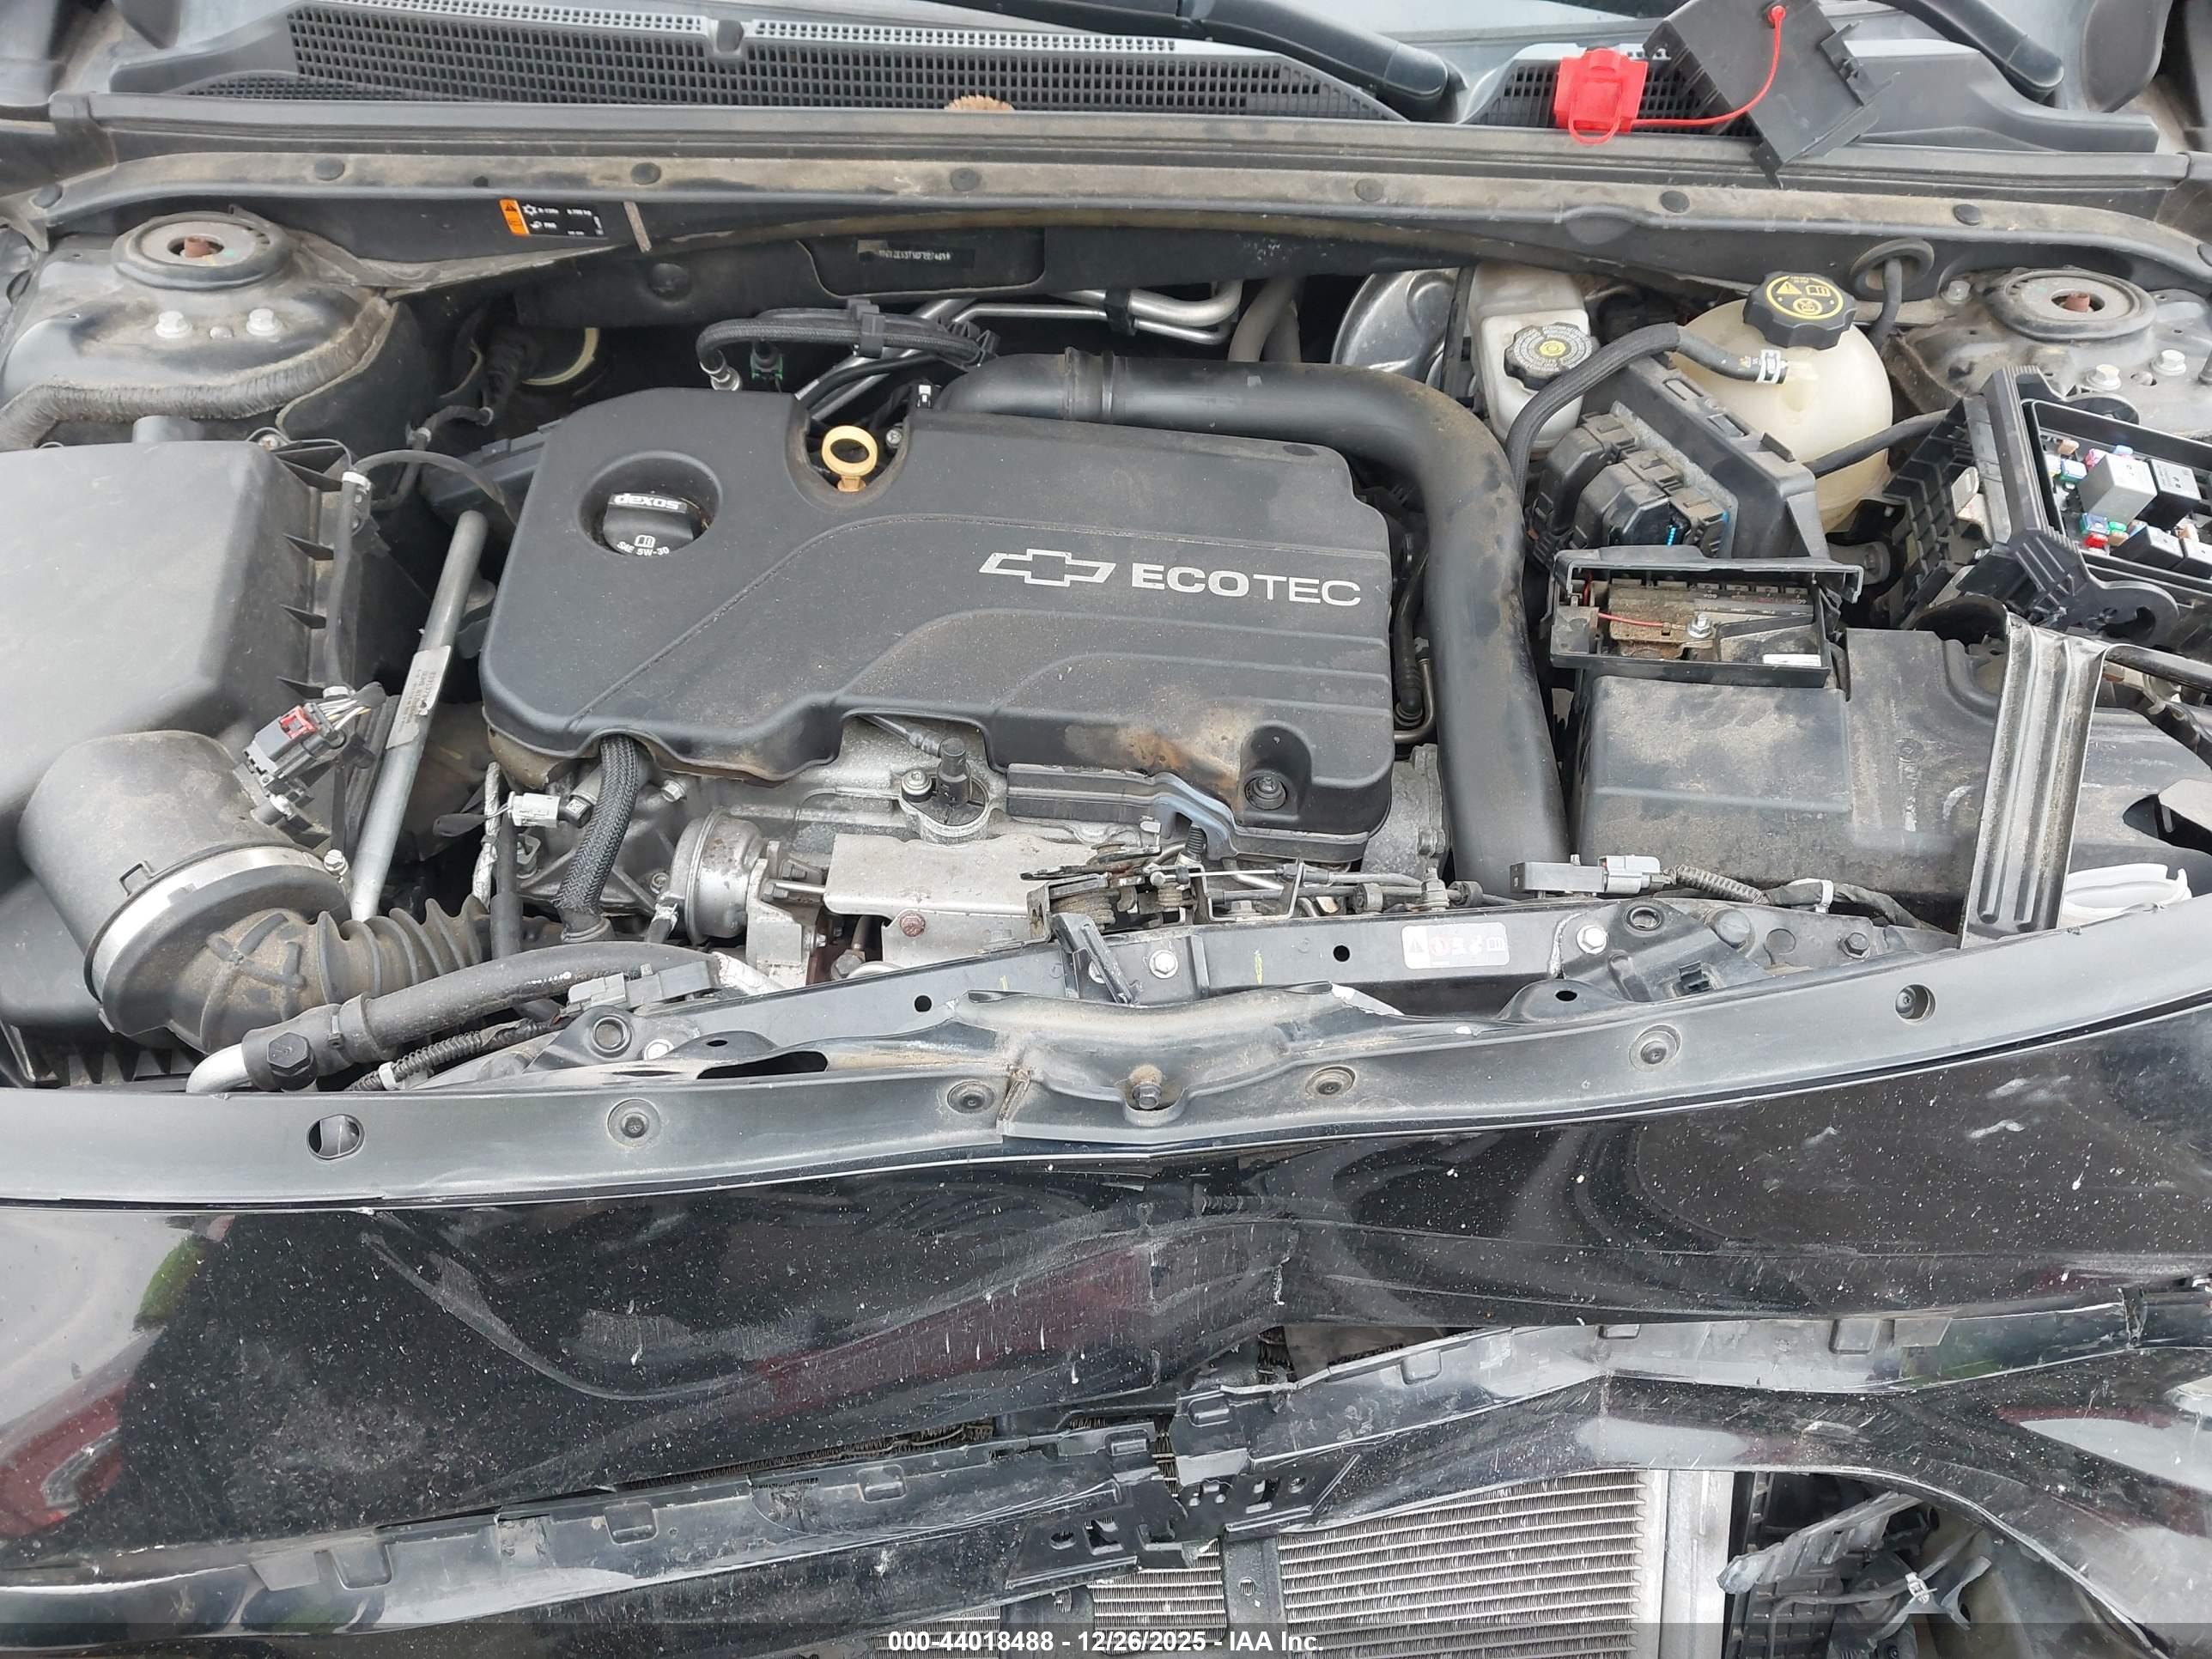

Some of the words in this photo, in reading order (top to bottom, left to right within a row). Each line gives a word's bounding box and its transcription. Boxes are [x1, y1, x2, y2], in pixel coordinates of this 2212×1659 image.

[614, 494, 680, 510] dexos
[617, 542, 635, 553] SAE
[636, 547, 670, 556] 5W-30
[1131, 562, 1362, 606] ECOTEC
